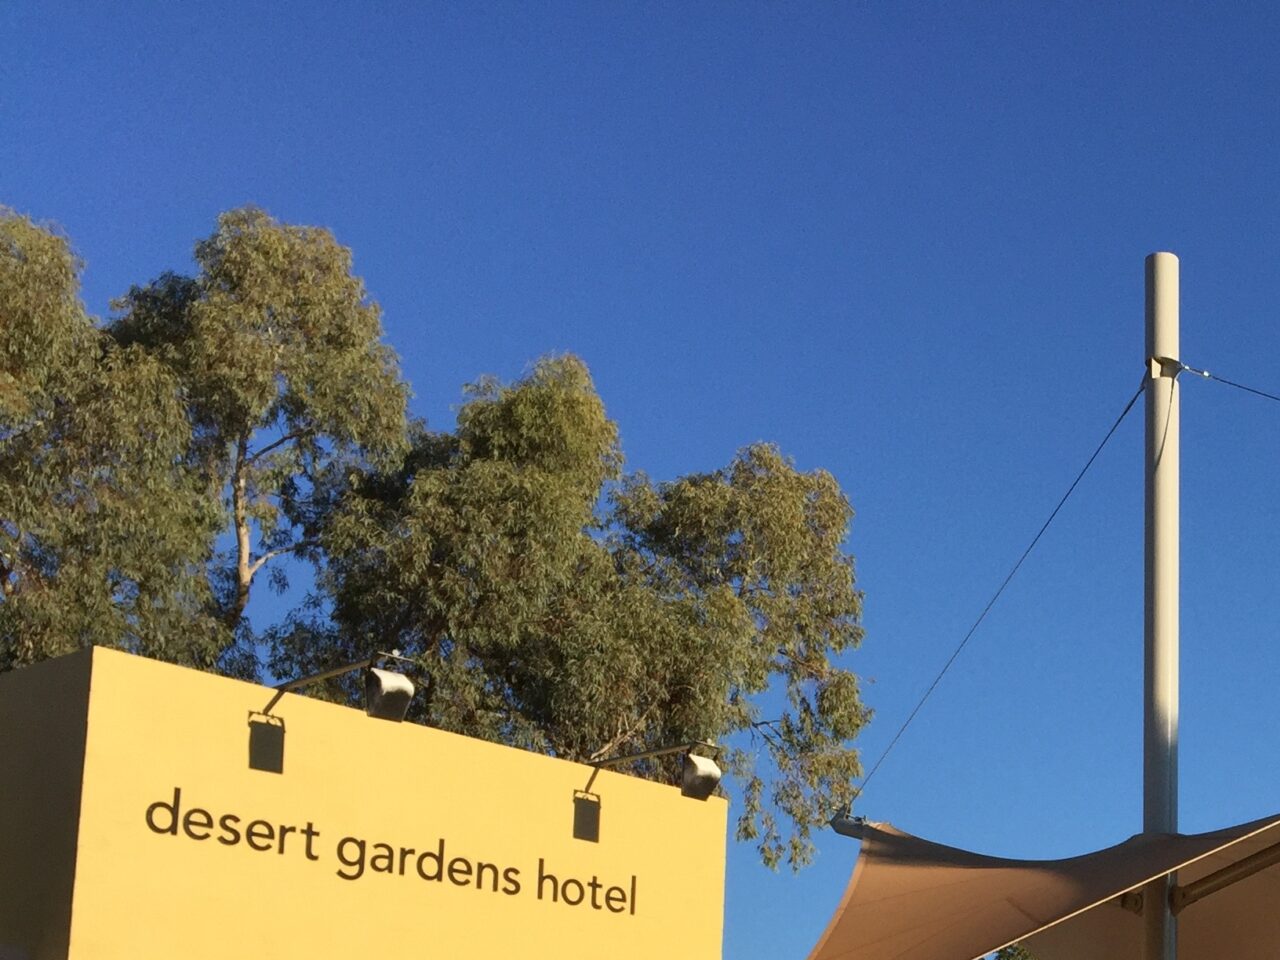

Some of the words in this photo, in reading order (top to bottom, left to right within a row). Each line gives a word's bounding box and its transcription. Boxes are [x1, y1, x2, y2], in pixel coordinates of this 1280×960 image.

[146, 788, 319, 860] desert
[337, 837, 520, 895] gardens
[538, 859, 636, 915] hotel
